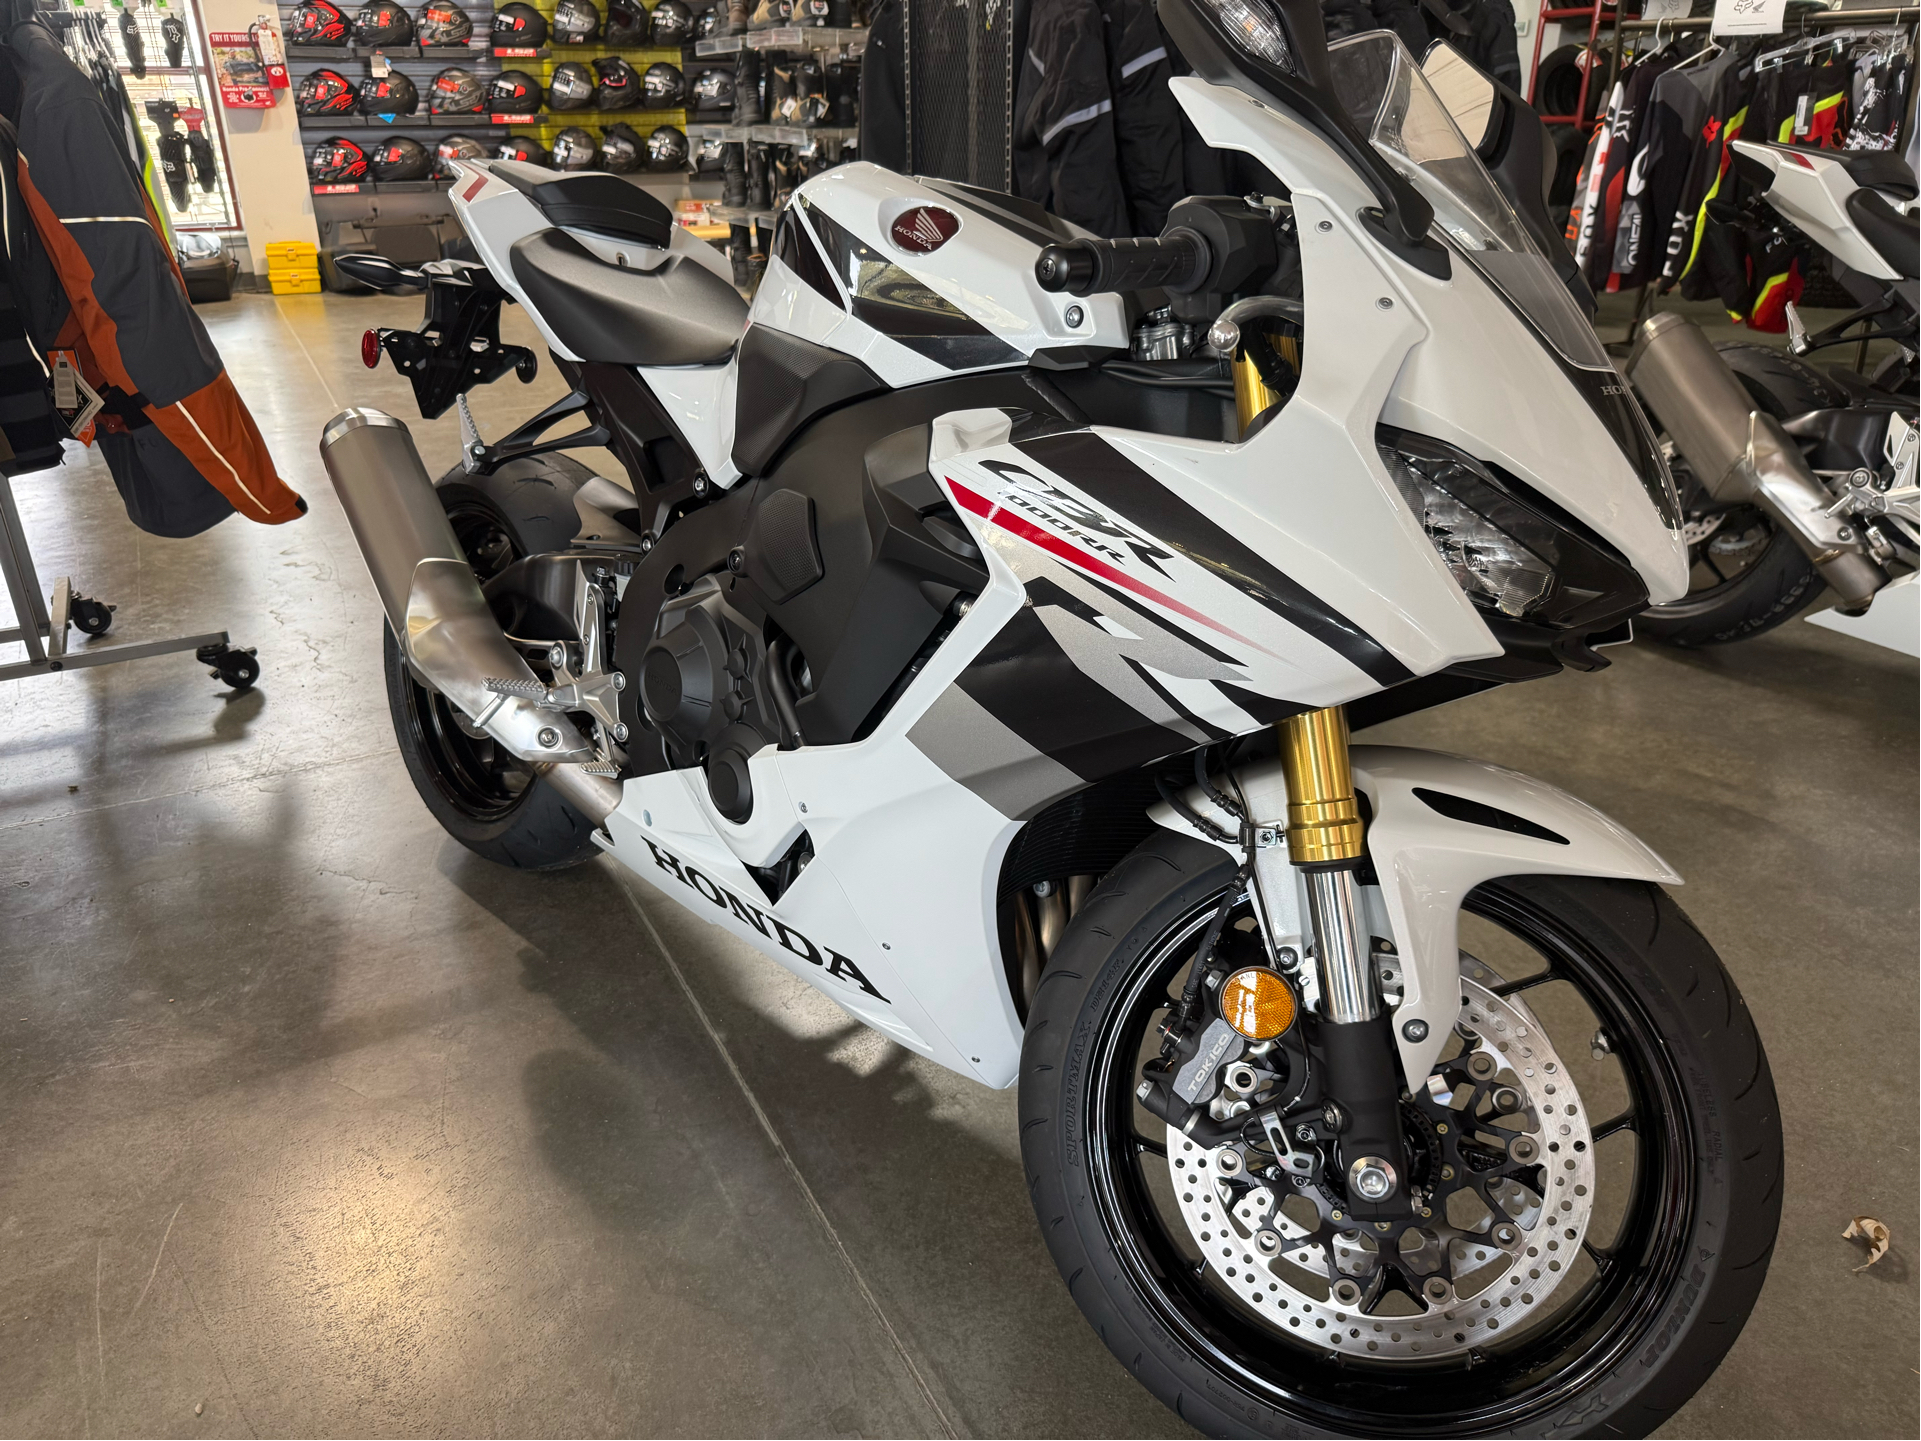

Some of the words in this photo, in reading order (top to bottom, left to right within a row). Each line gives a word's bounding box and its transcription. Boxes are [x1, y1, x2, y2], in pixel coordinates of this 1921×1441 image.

[893, 225, 933, 251] HONDA
[1662, 210, 1694, 277] FOX
[977, 459, 1177, 584] CBR
[646, 670, 679, 696] HONDA
[640, 835, 892, 1005] HONDA
[1066, 1021, 1092, 1167] SPORTMAX
[1187, 1033, 1229, 1092] TOKICO
[1697, 1071, 1717, 1117] TUBELESS
[1711, 1129, 1723, 1162] RADIAL
[1643, 1263, 1706, 1368] DUNLOP
